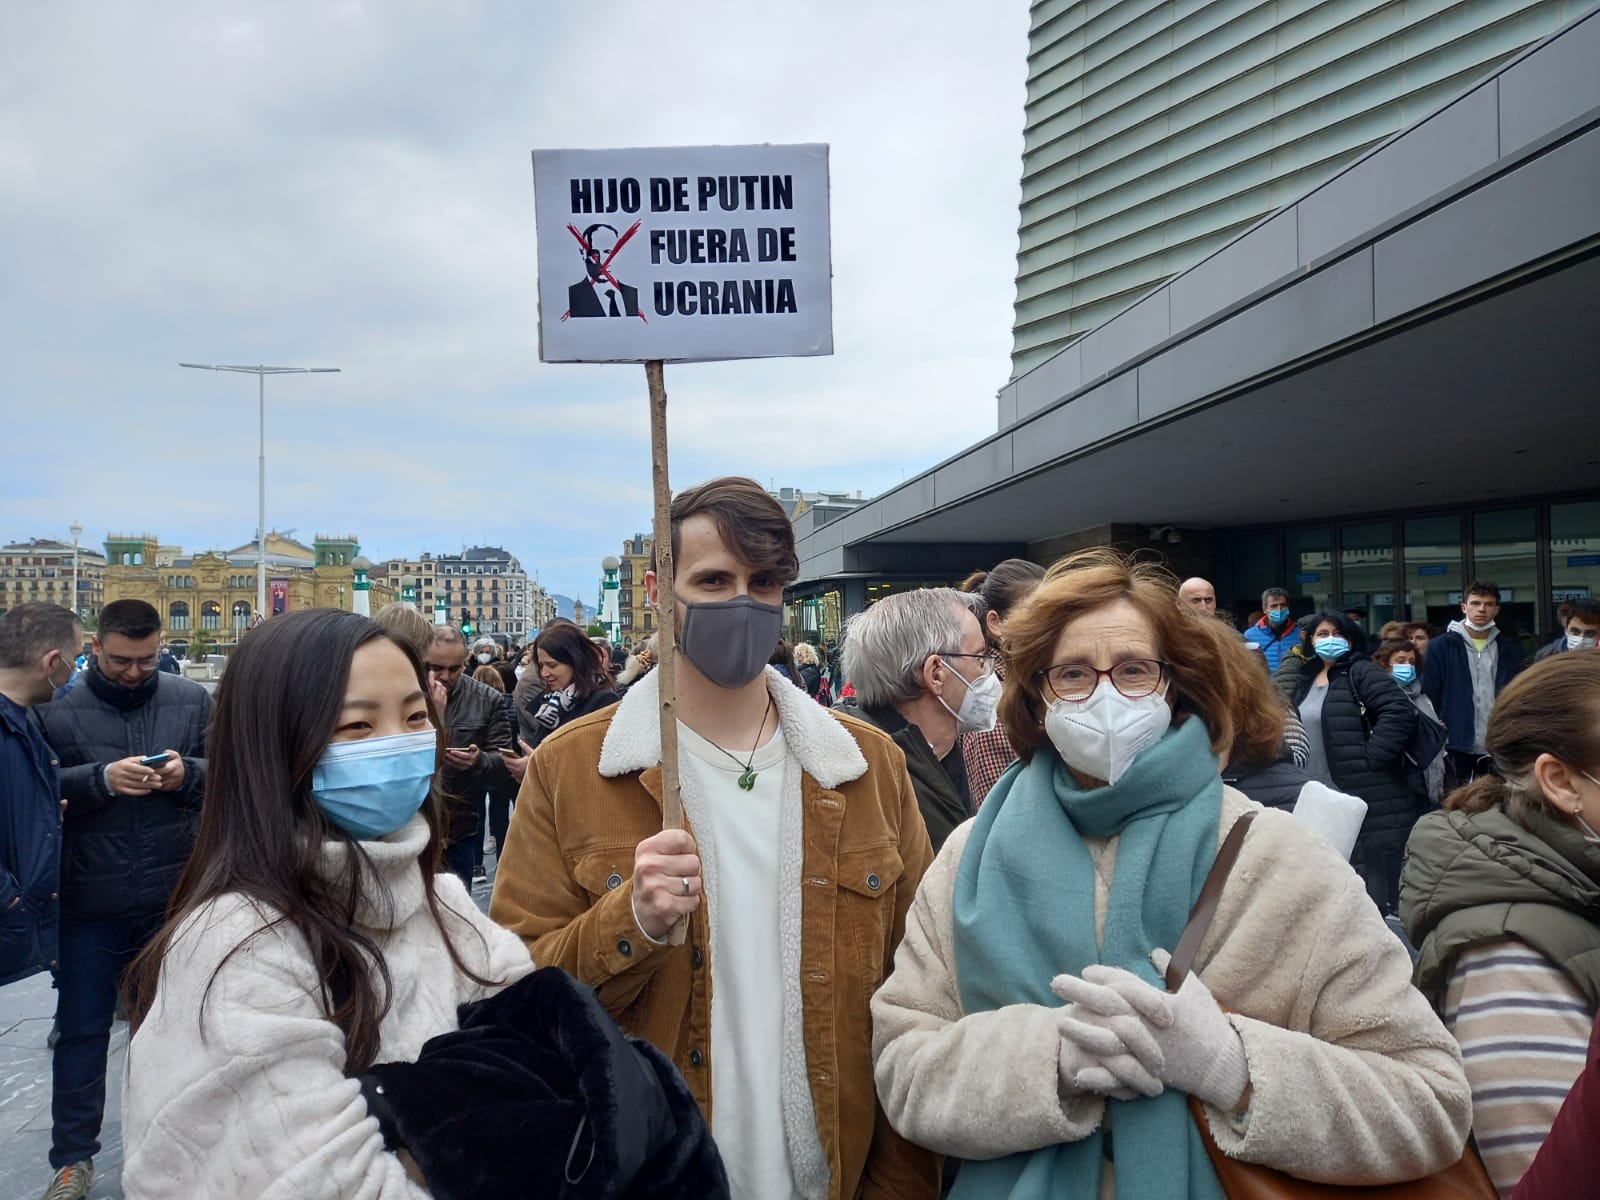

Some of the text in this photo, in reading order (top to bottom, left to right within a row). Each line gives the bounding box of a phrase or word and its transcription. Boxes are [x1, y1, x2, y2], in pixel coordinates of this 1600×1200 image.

[570, 175, 793, 213] HIJO DE PUTIN
[651, 227, 797, 264] FUERA DE
[653, 279, 798, 316] UCRANIA
